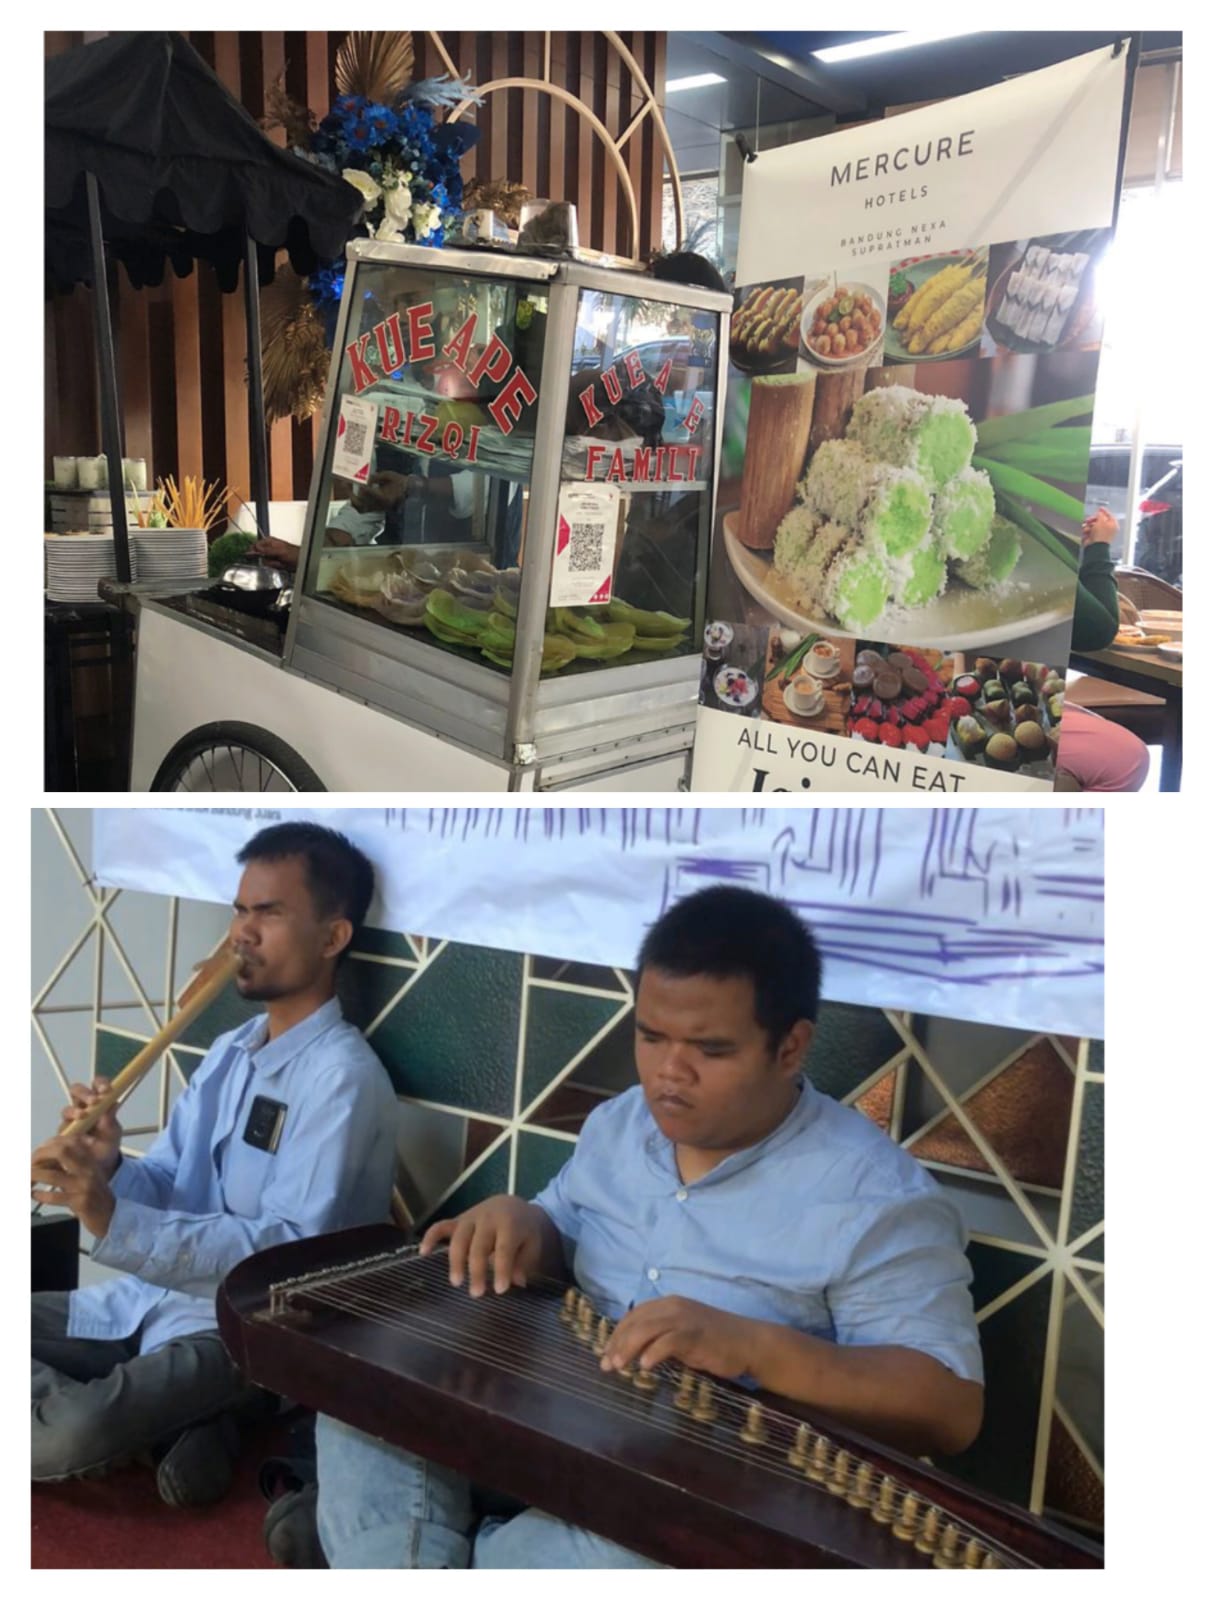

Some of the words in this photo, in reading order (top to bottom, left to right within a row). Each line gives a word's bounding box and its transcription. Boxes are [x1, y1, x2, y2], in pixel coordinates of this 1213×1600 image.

[830, 130, 976, 187] MERCURE
[864, 185, 929, 210] HOTELS
[840, 228, 902, 248] BANDUNG
[911, 220, 947, 235] NEXA
[851, 235, 932, 257] SUPRATMAN
[345, 301, 436, 396] KUE
[441, 311, 538, 436] APE
[578, 350, 646, 428] KUE
[379, 405, 482, 463] RIZQI
[583, 445, 699, 483] FAMILI
[737, 727, 778, 754] ALL
[786, 737, 837, 767] YOU
[845, 751, 901, 783] CAN
[911, 765, 967, 792] EAT
